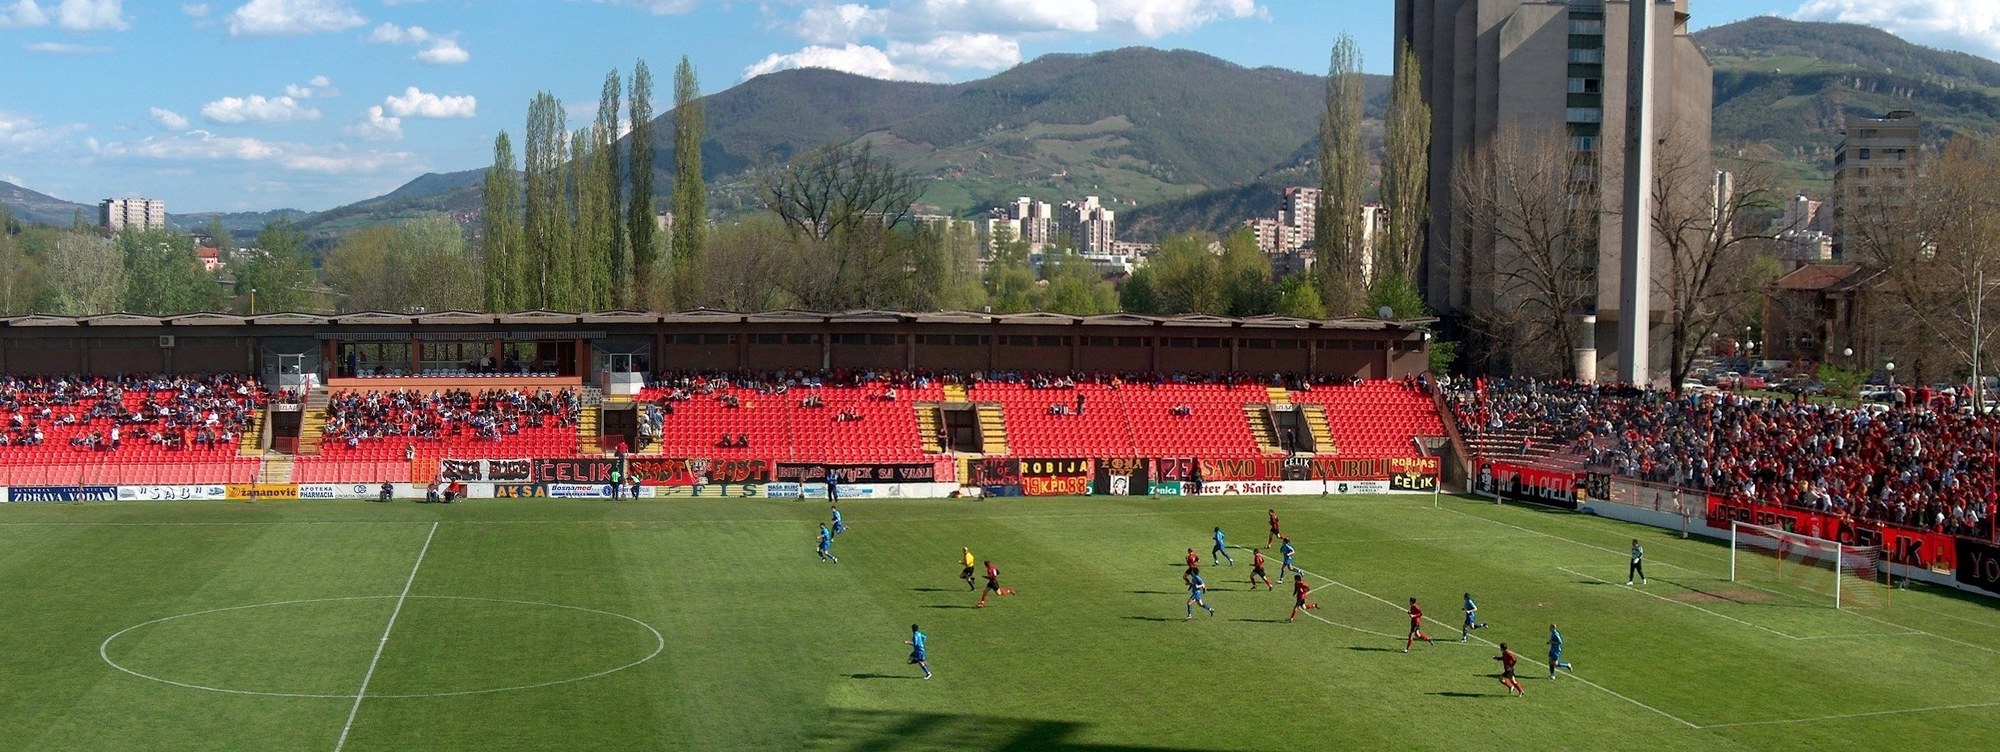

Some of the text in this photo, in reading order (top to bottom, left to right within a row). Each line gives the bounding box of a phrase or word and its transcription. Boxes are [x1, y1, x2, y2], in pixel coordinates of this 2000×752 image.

[541, 459, 612, 481] ČELIK
[1021, 461, 1088, 473] ROBIJA
[1202, 459, 1256, 478] SAMO
[496, 486, 546, 498] AKSA
[691, 484, 757, 497] FIS
[1183, 483, 1220, 494] Rtter
[14, 493, 103, 502] ZDRAVA VODA
